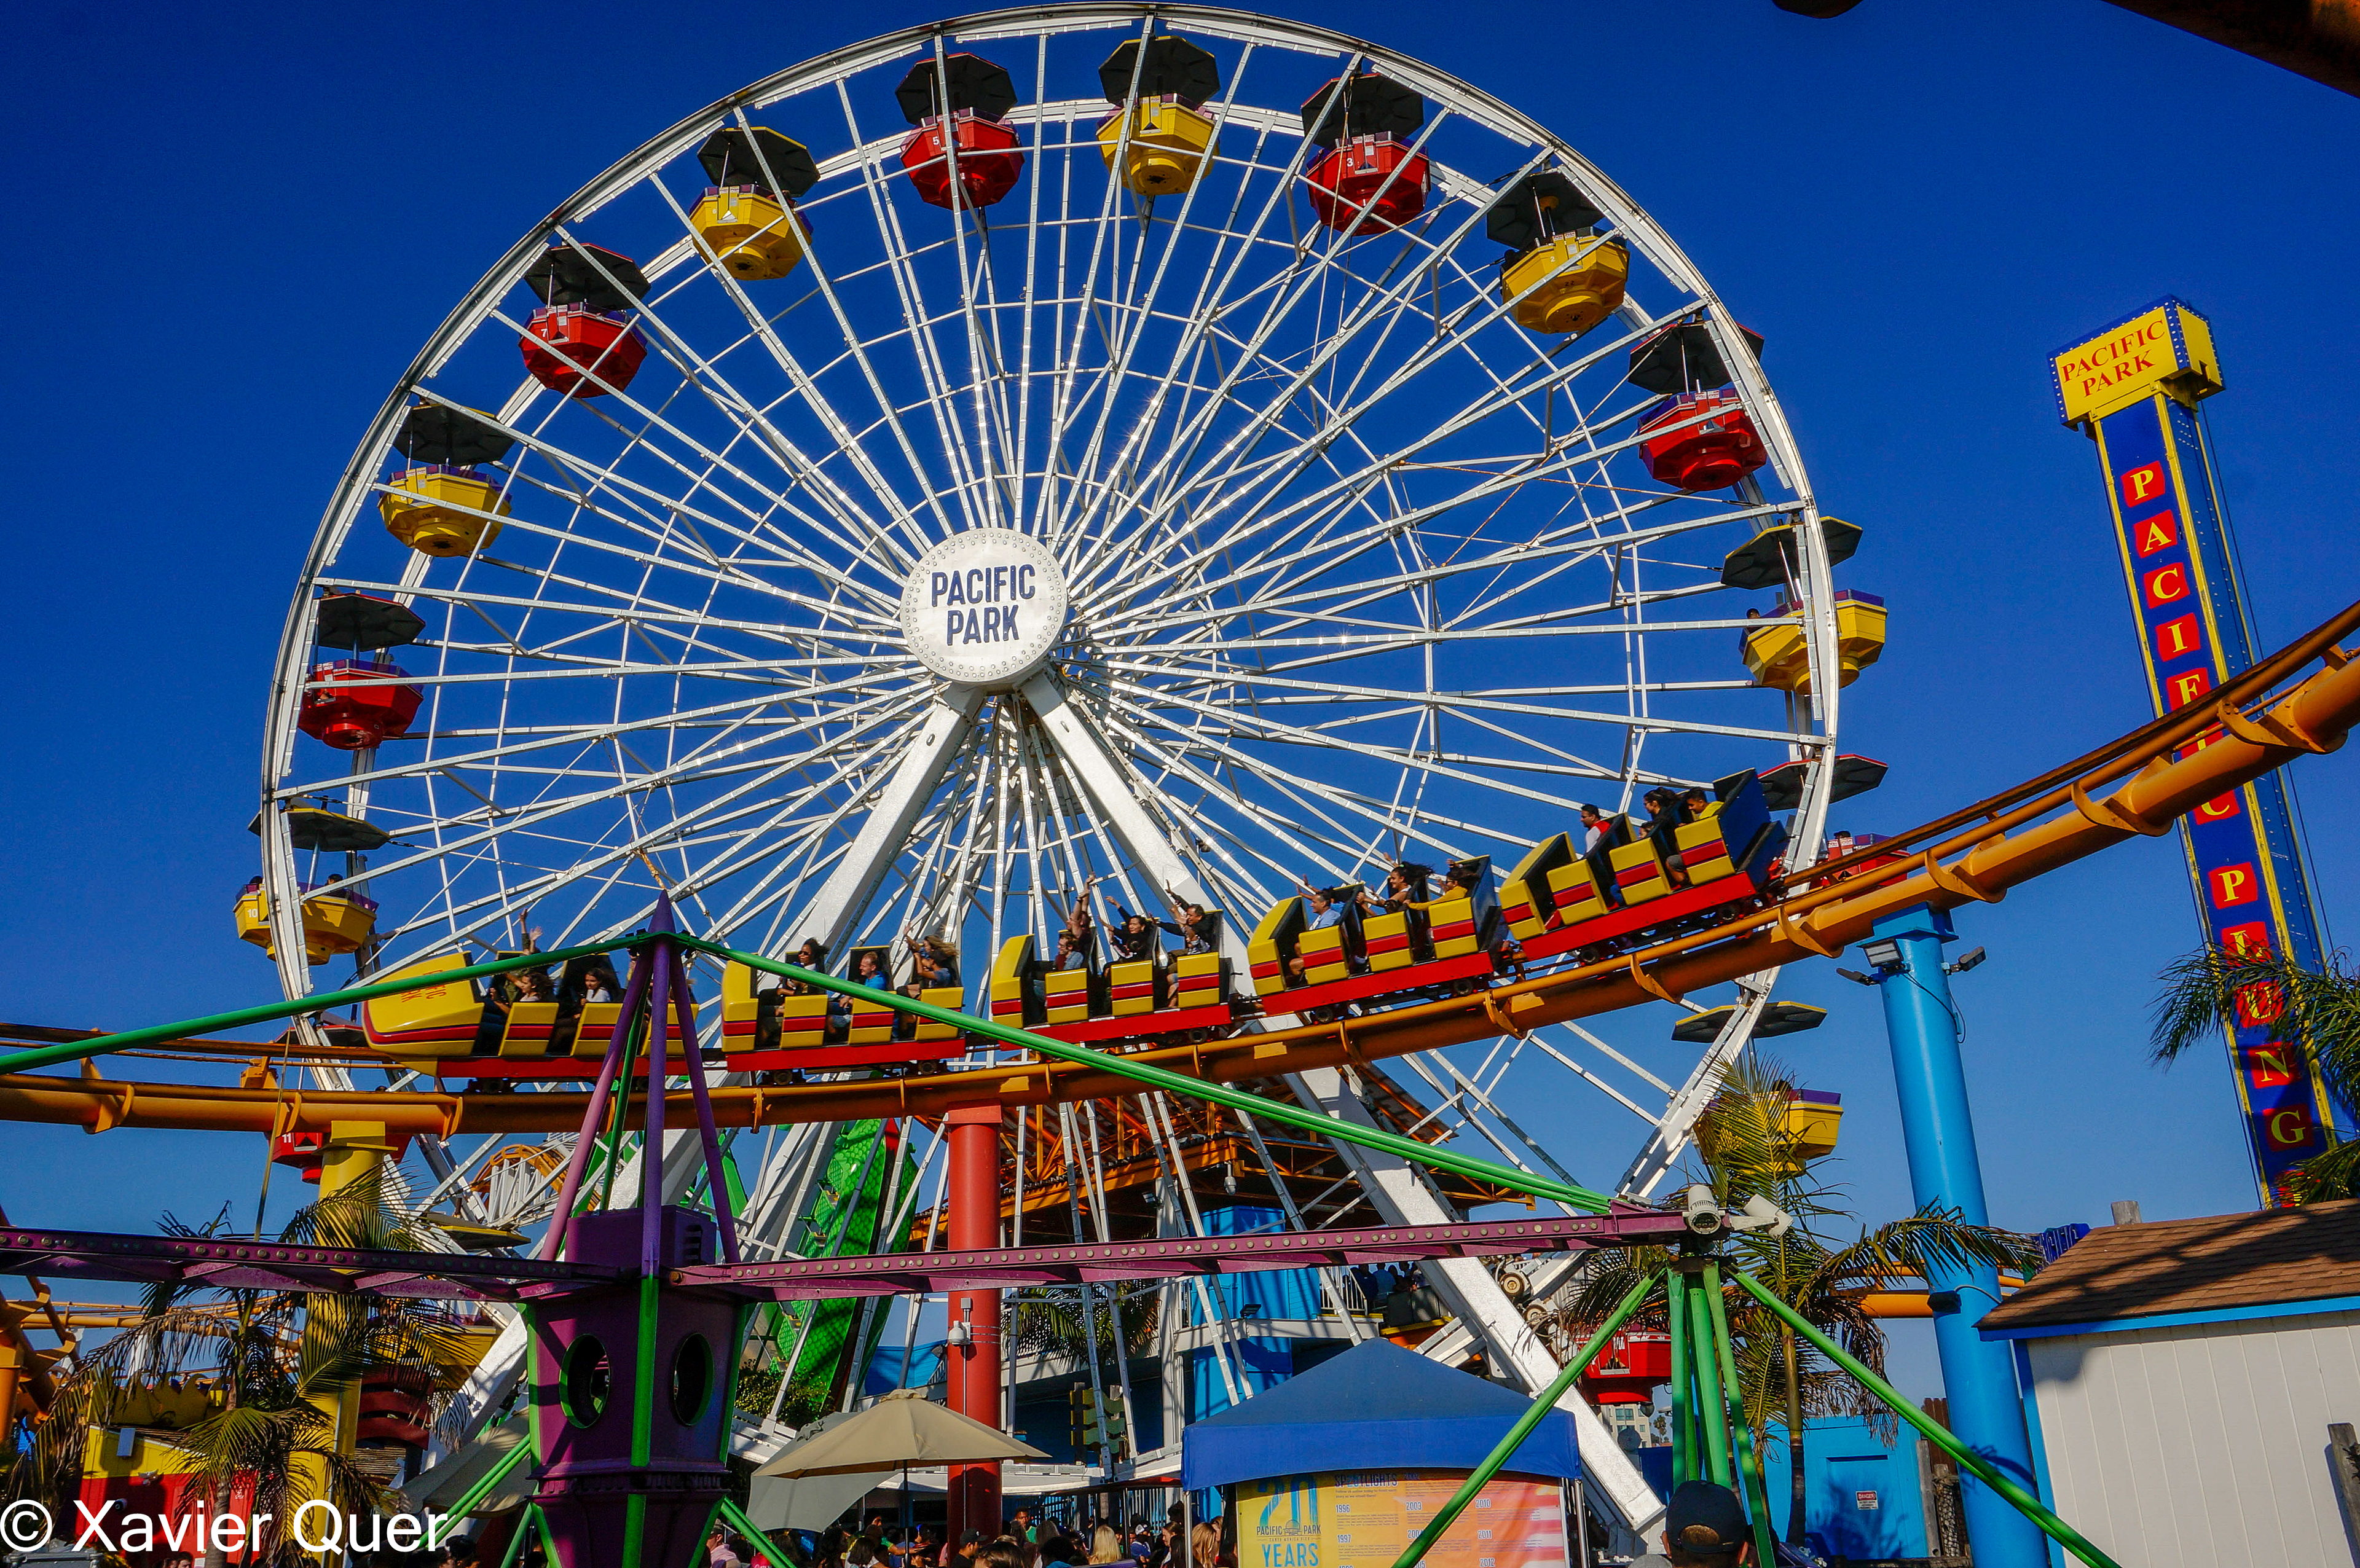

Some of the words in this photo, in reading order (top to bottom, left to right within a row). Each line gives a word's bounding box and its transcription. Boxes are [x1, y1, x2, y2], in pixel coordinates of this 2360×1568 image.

[933, 136, 939, 145] 5
[1347, 157, 1353, 167] 3
[2061, 319, 2165, 383] PACIFIC
[2081, 349, 2155, 397] PARK
[931, 563, 1036, 607] PACIFIC
[946, 605, 1020, 646] PARK
[247, 909, 258, 917] 10
[2219, 869, 2308, 1207] PLUNG
[282, 1133, 291, 1143] 11
[1336, 1504, 1350, 1513] 1996
[1406, 1502, 1422, 1510] 2003
[1476, 1499, 1491, 1508] 2010
[1256, 1526, 1283, 1535] PACIFIC
[1303, 1524, 1321, 1534] PARK
[1477, 1530, 1492, 1539] 2011
[1337, 1534, 1351, 1543] 1997
[1261, 1543, 1319, 1567] YEARS
[1480, 1558, 1495, 1567] 2012
